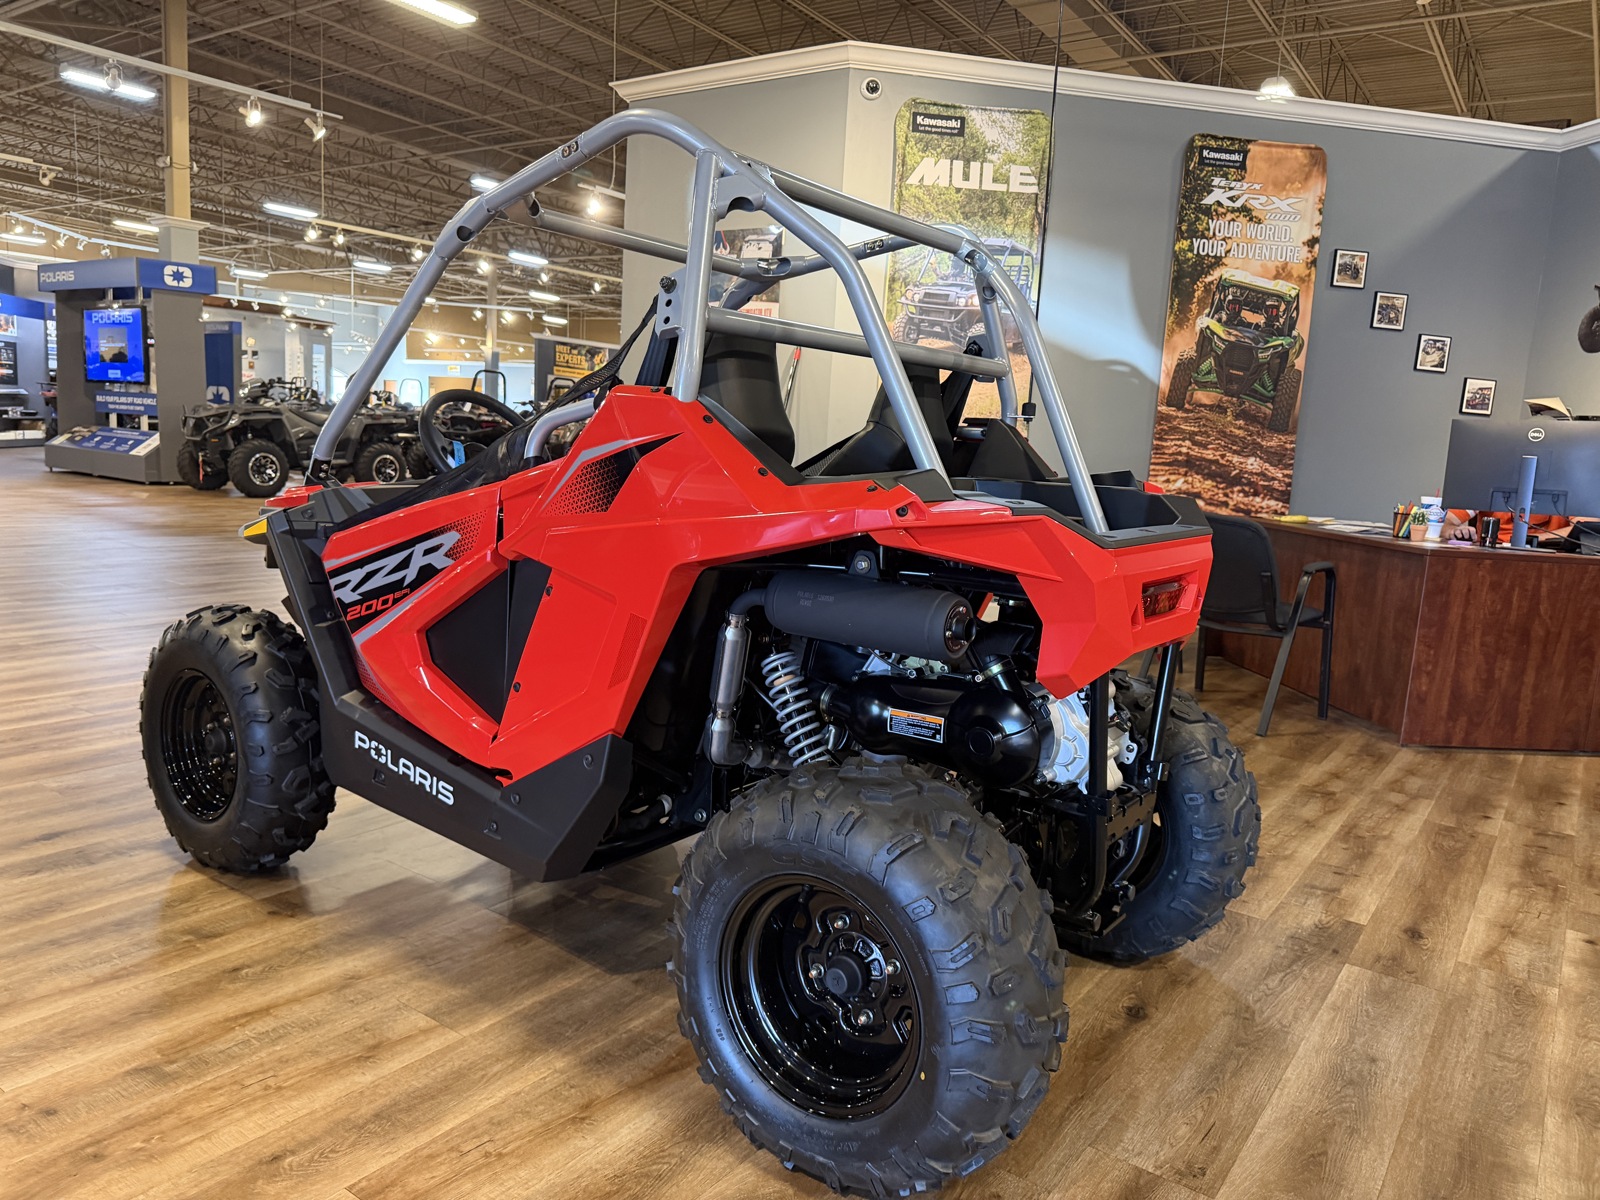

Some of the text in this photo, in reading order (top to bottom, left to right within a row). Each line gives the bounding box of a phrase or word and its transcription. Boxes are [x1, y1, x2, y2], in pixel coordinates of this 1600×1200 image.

[916, 115, 961, 128] Kawasaki
[1202, 149, 1244, 162] Kawasaki
[905, 157, 1040, 194] MULE
[1200, 187, 1304, 213] KRX
[1265, 212, 1302, 222] 1000
[1208, 218, 1294, 242] YOUR WORLD.
[1192, 238, 1304, 264] YOUR ADVENTURE.
[40, 270, 75, 283] POLARIS
[91, 311, 134, 324] POLARIS
[555, 344, 571, 354] MEET
[556, 352, 586, 366] EXPERTS
[329, 530, 462, 604] RZR
[346, 588, 411, 621] 200 EFI
[354, 730, 455, 806] POLARIS
